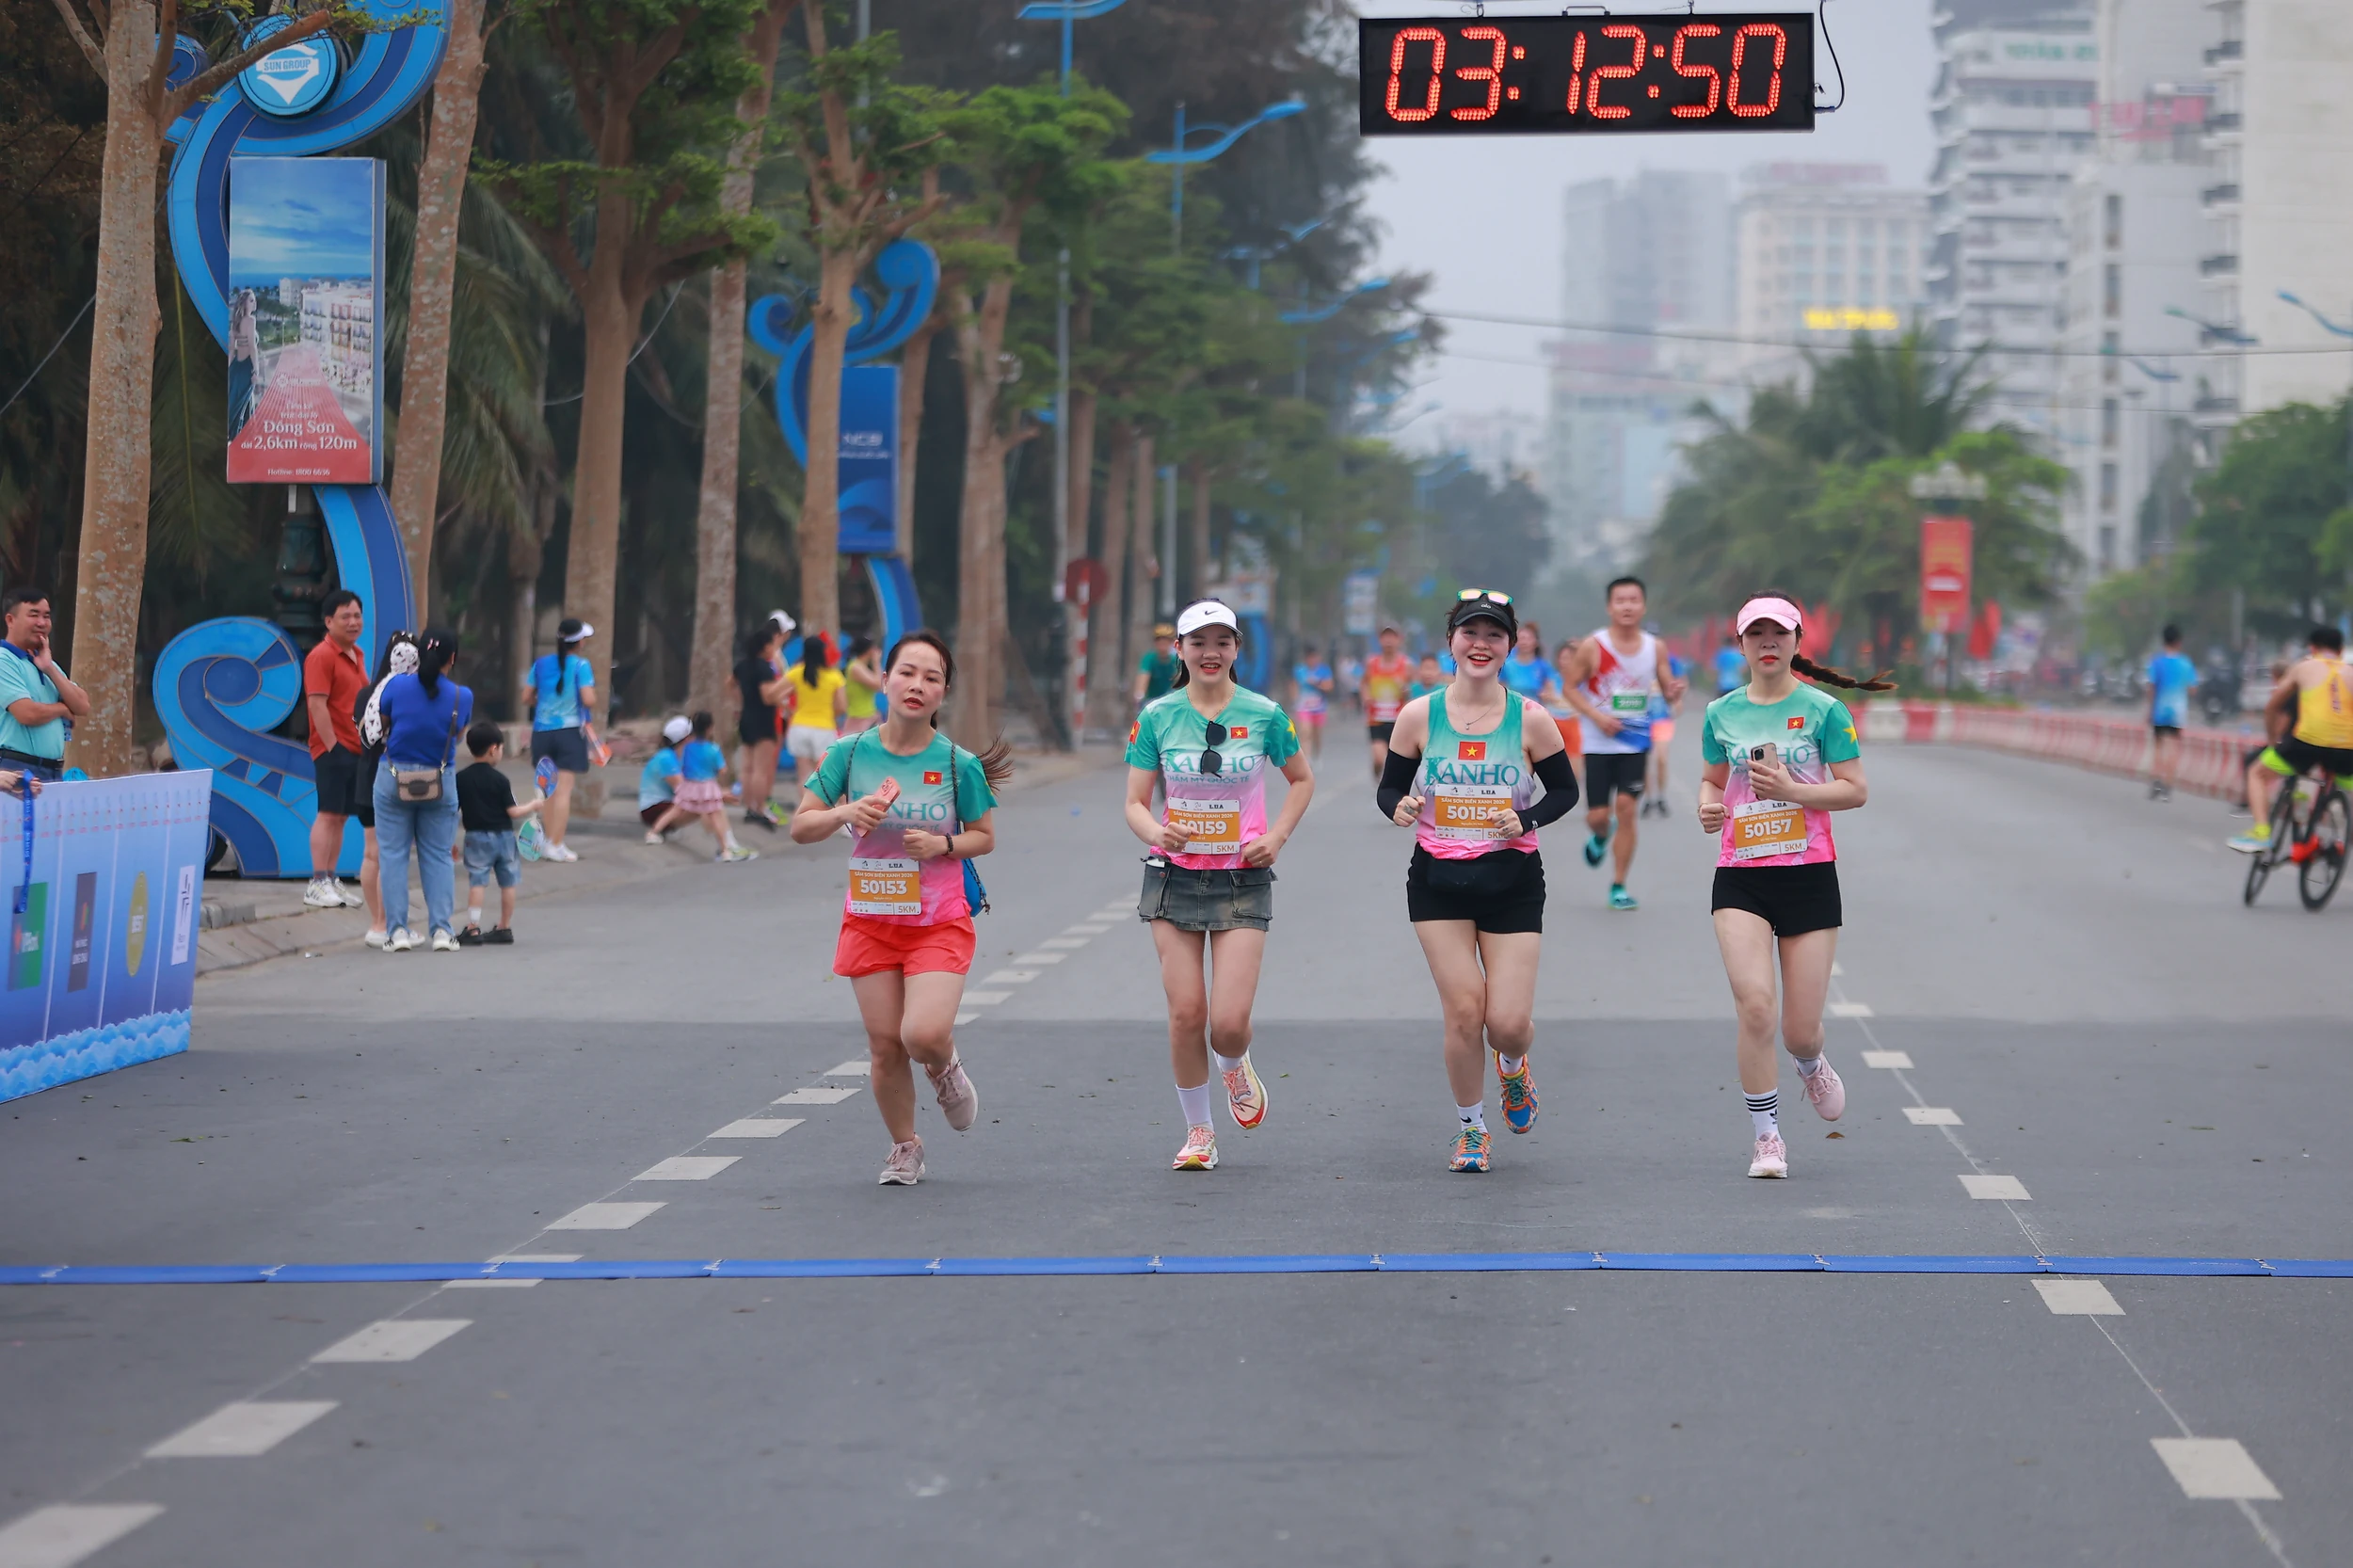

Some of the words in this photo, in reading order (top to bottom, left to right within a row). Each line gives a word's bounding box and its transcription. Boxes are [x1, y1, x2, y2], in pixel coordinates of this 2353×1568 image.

[264, 61, 281, 71] SUN
[283, 58, 312, 70] GROUP
[306, 420, 335, 434] Sơn
[254, 436, 297, 452] 2,6km
[319, 437, 358, 450] 120m
[1164, 750, 1255, 774] KAHO
[1725, 742, 1810, 766] KAHO
[1424, 757, 1520, 786] KANHO
[1745, 819, 1792, 839] 50157
[860, 879, 907, 894] 50153
